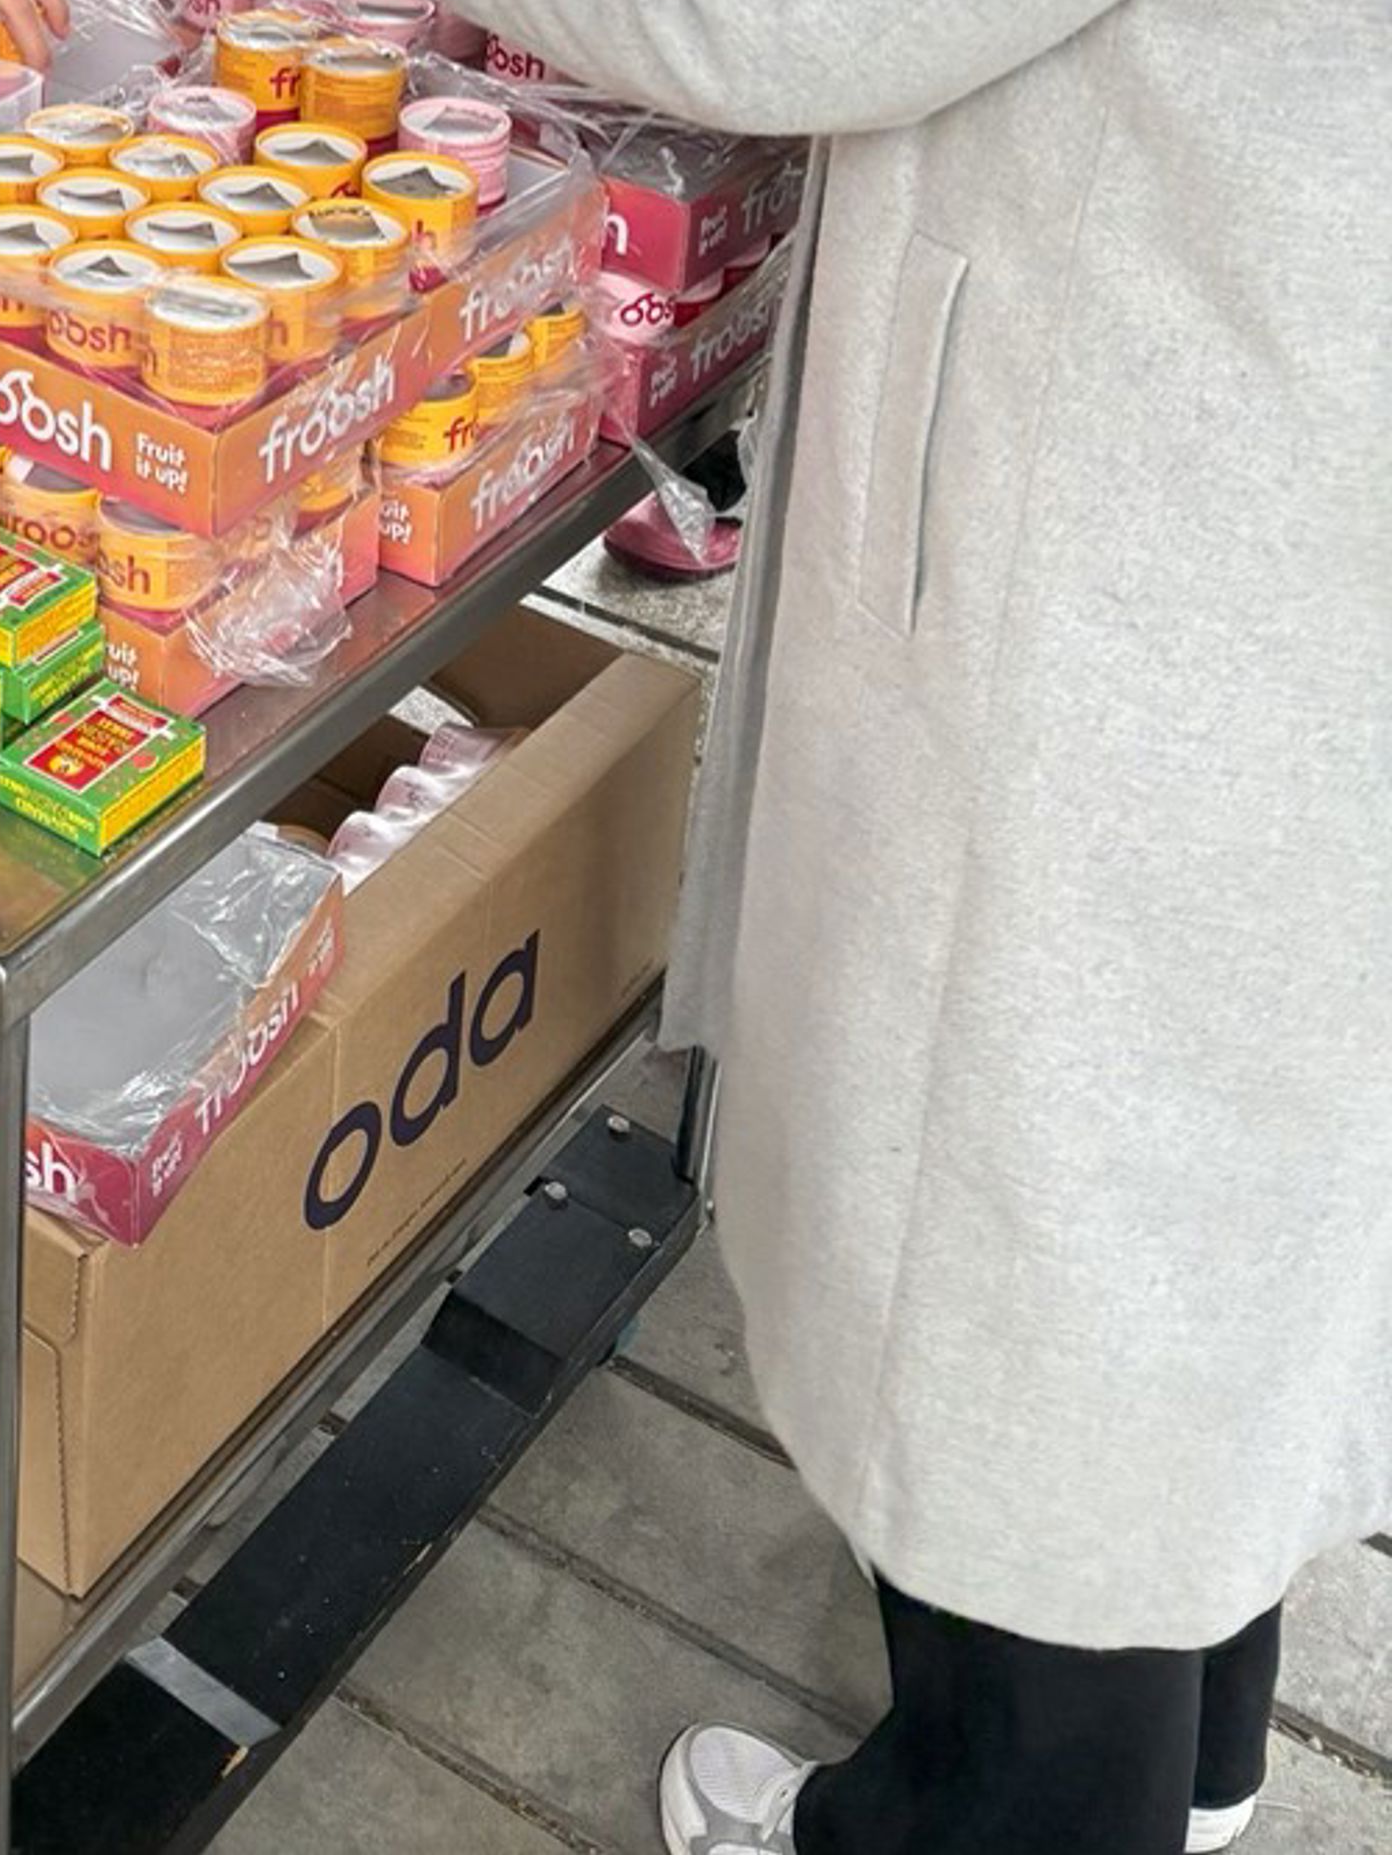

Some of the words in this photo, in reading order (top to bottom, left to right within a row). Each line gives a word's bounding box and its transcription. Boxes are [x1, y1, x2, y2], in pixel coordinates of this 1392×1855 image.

[135, 432, 187, 468] Fruit
[259, 351, 395, 483] froosh
[135, 457, 154, 480] it
[156, 462, 188, 495] up!
[304, 928, 540, 1231] oda
